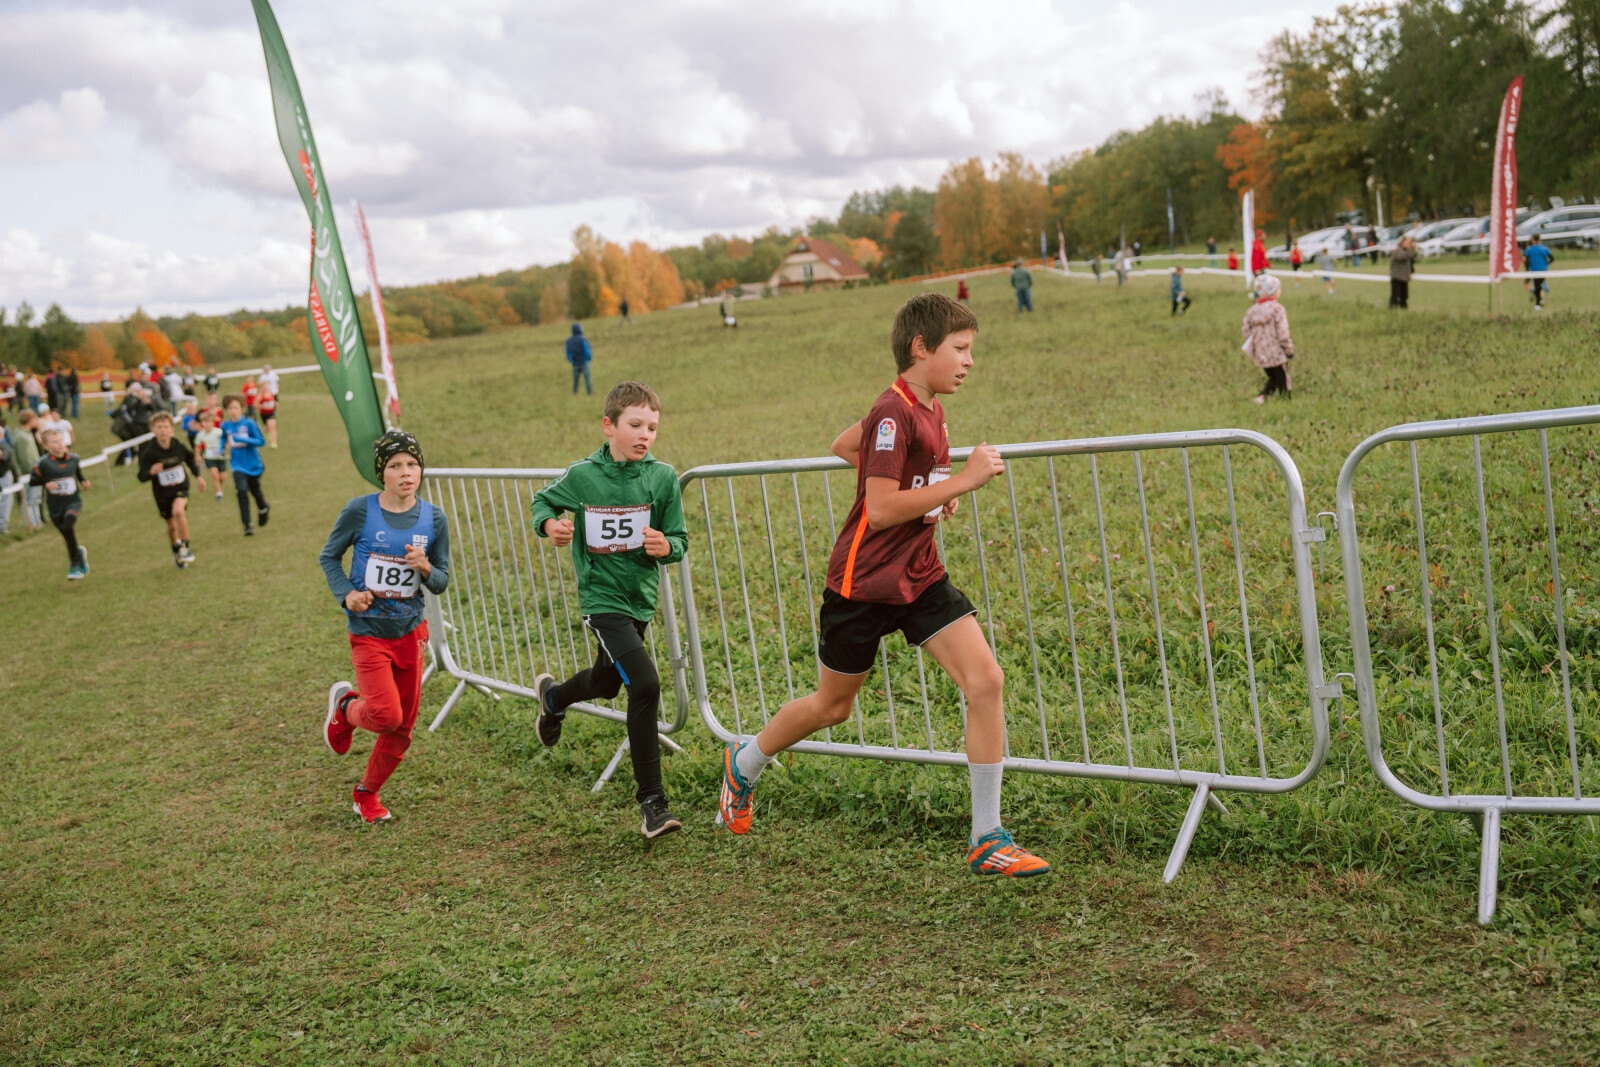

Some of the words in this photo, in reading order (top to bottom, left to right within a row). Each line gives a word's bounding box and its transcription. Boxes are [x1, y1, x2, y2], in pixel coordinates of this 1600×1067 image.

[1504, 208, 1514, 273] ATVIJAS
[601, 518, 634, 540] 55
[375, 564, 415, 587] 182
